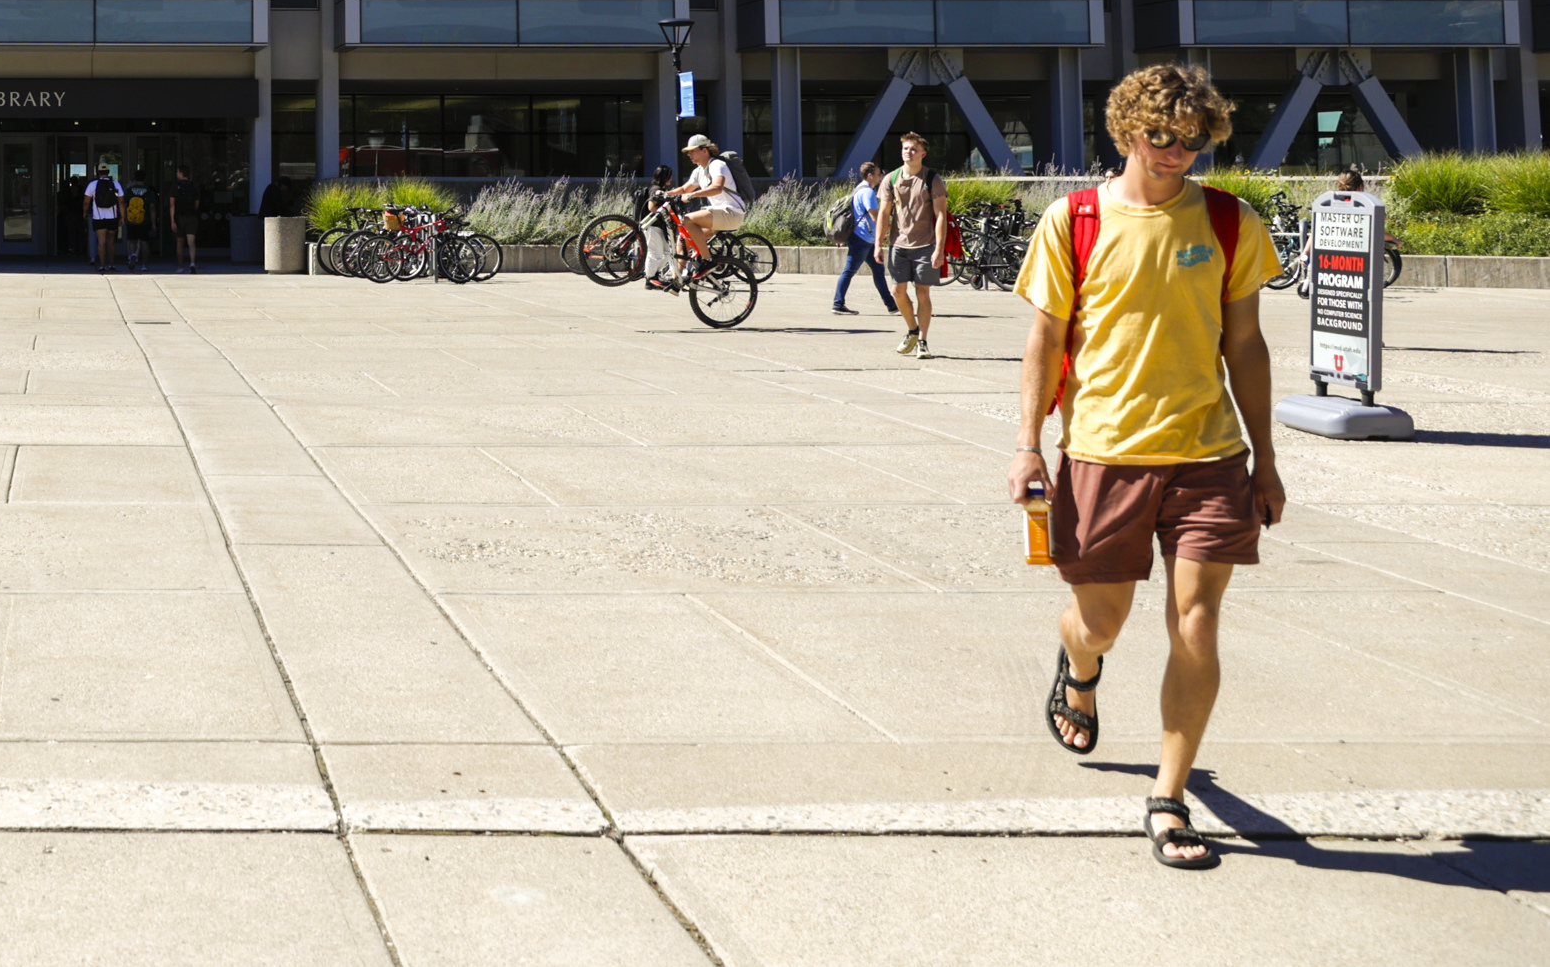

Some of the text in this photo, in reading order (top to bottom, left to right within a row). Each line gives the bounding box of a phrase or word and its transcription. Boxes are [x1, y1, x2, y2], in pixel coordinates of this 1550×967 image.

[1320, 212, 1365, 224] MASTER OF
[1320, 226, 1364, 238] SOFTWARE
[1320, 239, 1363, 249] DEVELOPMENT
[1318, 254, 1364, 272] 16-MONTH
[1318, 273, 1363, 289] PROGRAM
[1317, 296, 1363, 311] FOR THOSE WITH
[1317, 317, 1363, 331] BACKGROUND
